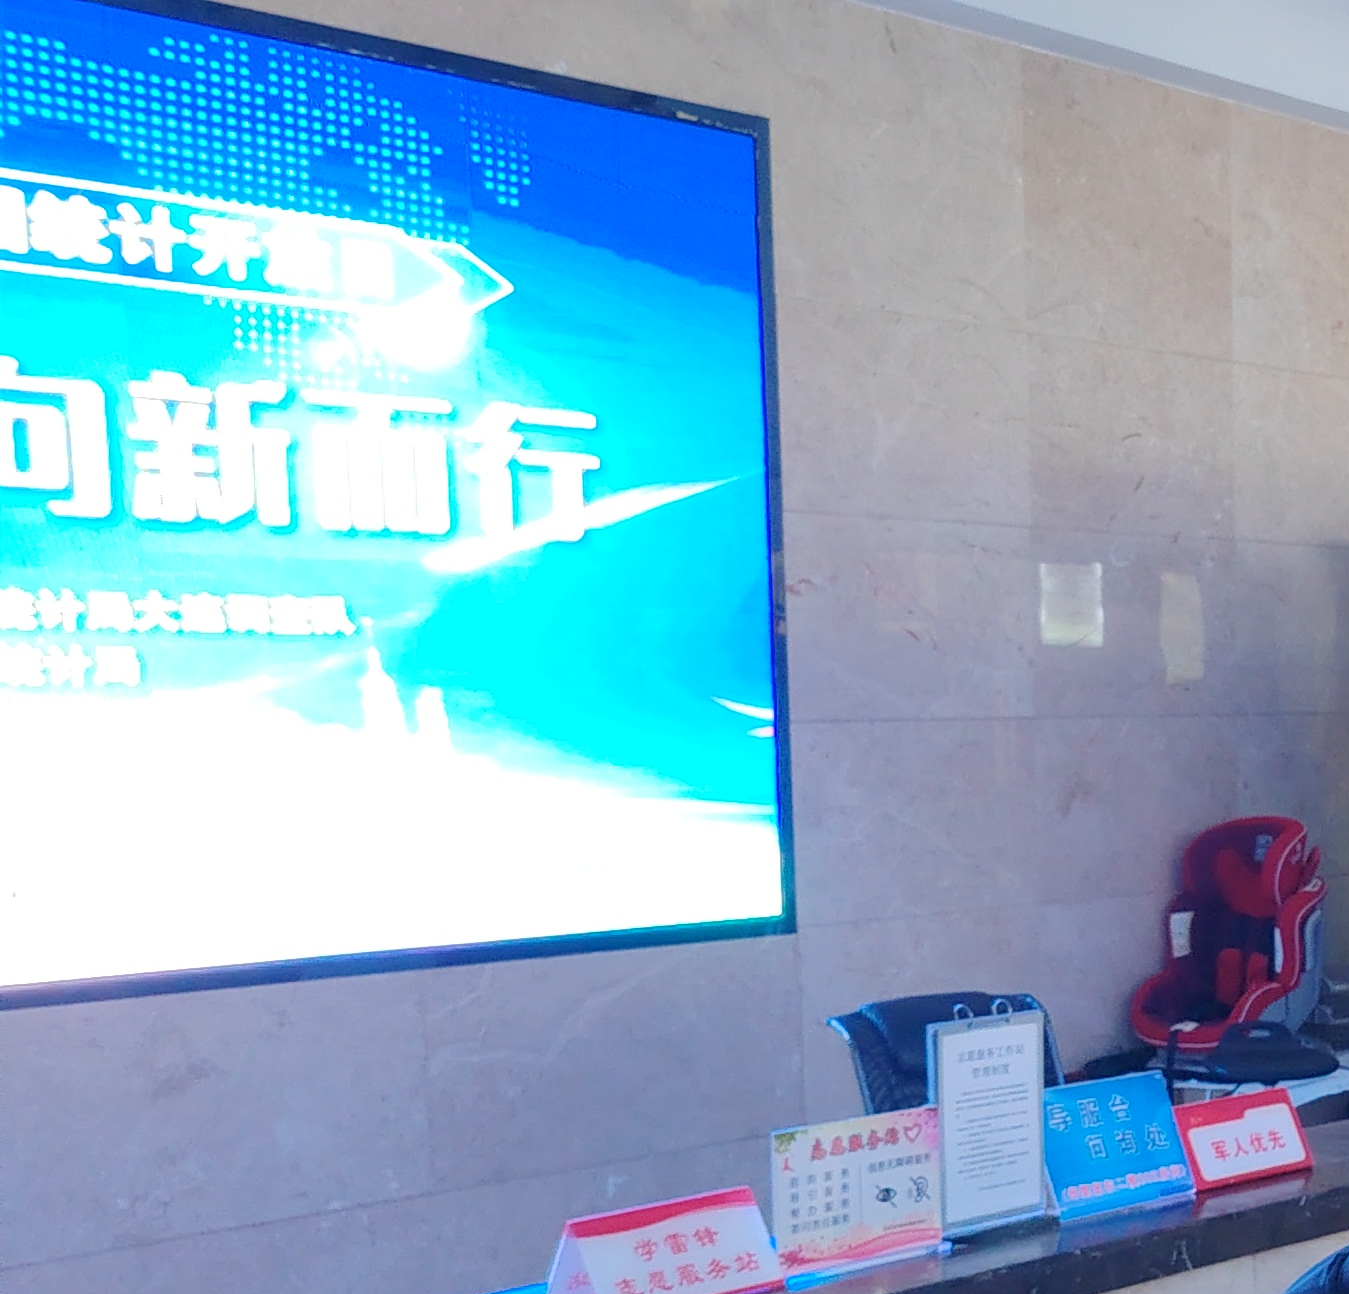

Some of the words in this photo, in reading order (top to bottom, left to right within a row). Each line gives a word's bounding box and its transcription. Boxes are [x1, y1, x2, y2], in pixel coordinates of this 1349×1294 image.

[0, 355, 600, 542] 向新而行
[1210, 1130, 1286, 1162] 军人优先
[633, 1226, 720, 1263] 学雷锋
